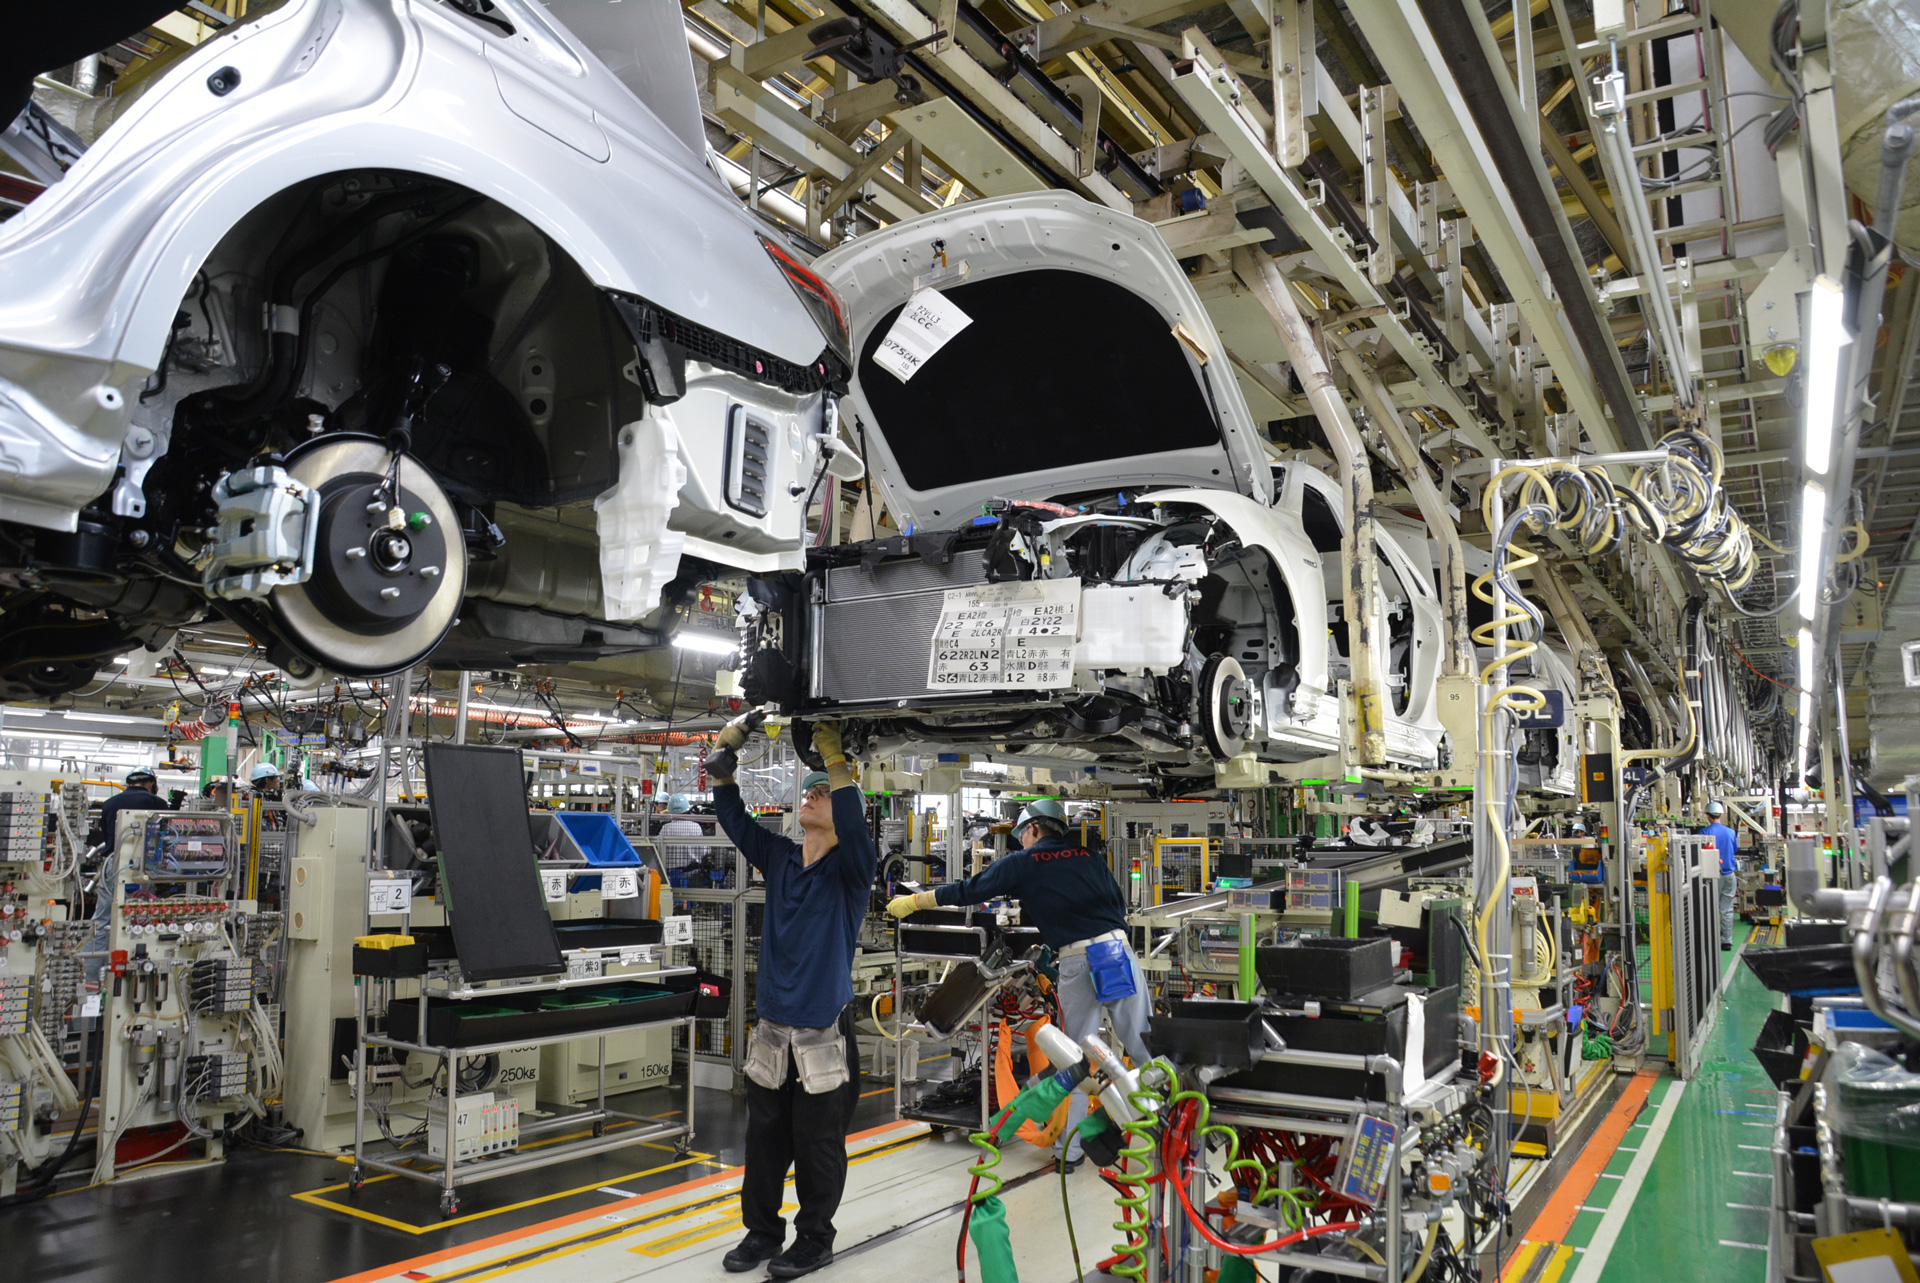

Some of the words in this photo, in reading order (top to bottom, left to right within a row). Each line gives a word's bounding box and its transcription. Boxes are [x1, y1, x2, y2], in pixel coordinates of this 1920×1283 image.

[990, 638, 995, 648] 5
[1018, 638, 1026, 646] E
[1061, 649, 1071, 658] 有
[938, 663, 947, 672] 赤
[969, 662, 988, 671] 63
[1060, 661, 1070, 669] 有
[1006, 673, 1025, 682] 12
[1624, 772, 1640, 781] 4L
[1031, 848, 1090, 862] TOYOTA
[551, 878, 561, 891] 赤
[619, 877, 631, 889] 赤
[395, 888, 402, 900] 2
[678, 922, 687, 934] 黒
[500, 1066, 536, 1083] 250kg
[641, 1063, 669, 1078] 150kg
[458, 1114, 467, 1125] 47
